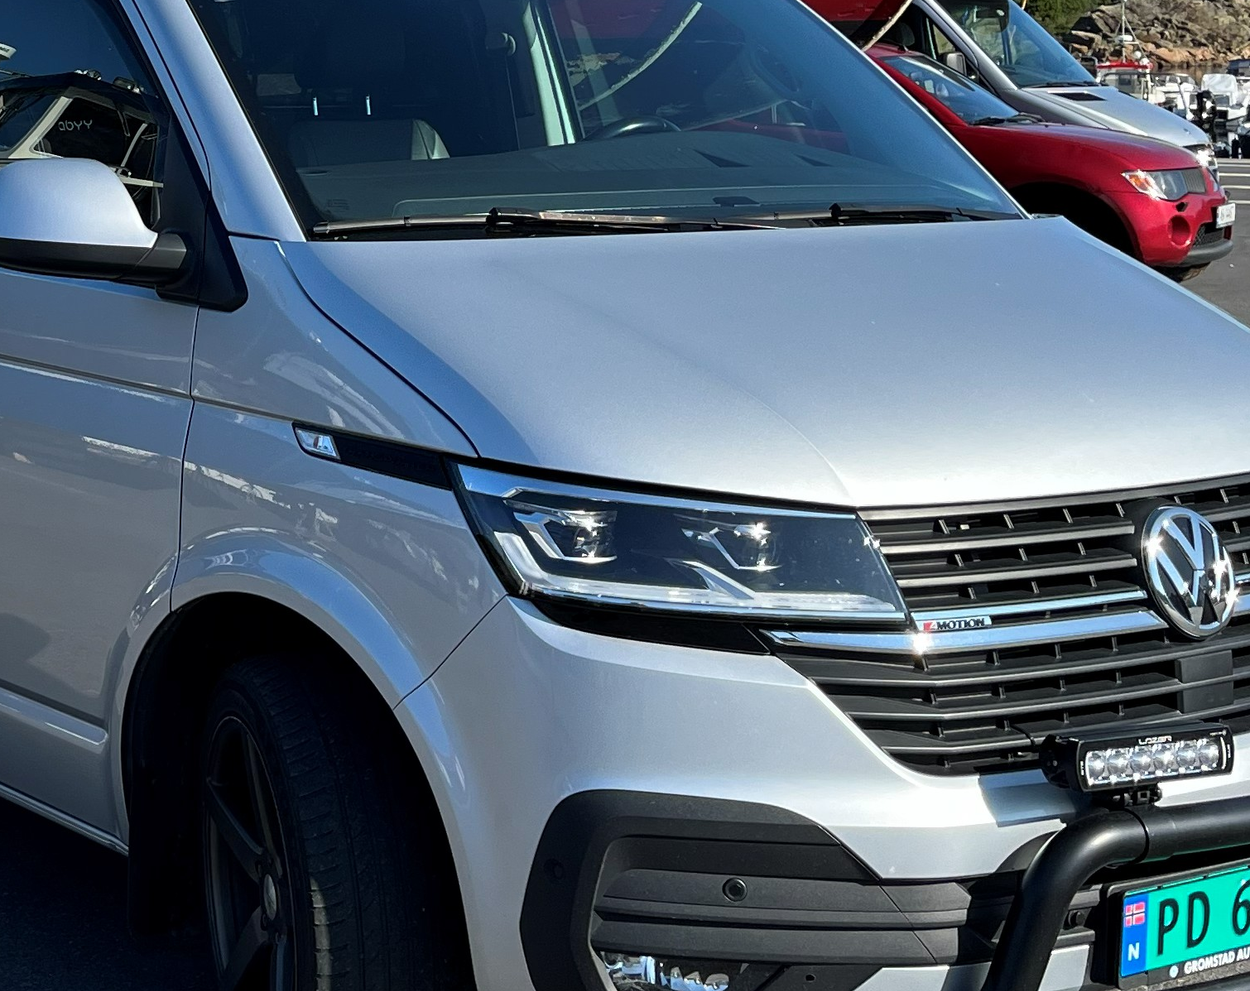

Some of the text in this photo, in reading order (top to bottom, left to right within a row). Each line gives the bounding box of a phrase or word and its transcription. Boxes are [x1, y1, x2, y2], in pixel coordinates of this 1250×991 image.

[923, 617, 985, 631] 4MOTION
[1157, 891, 1210, 956] PD
[1127, 942, 1140, 962] N
[1183, 950, 1236, 974] GROMSTAD
